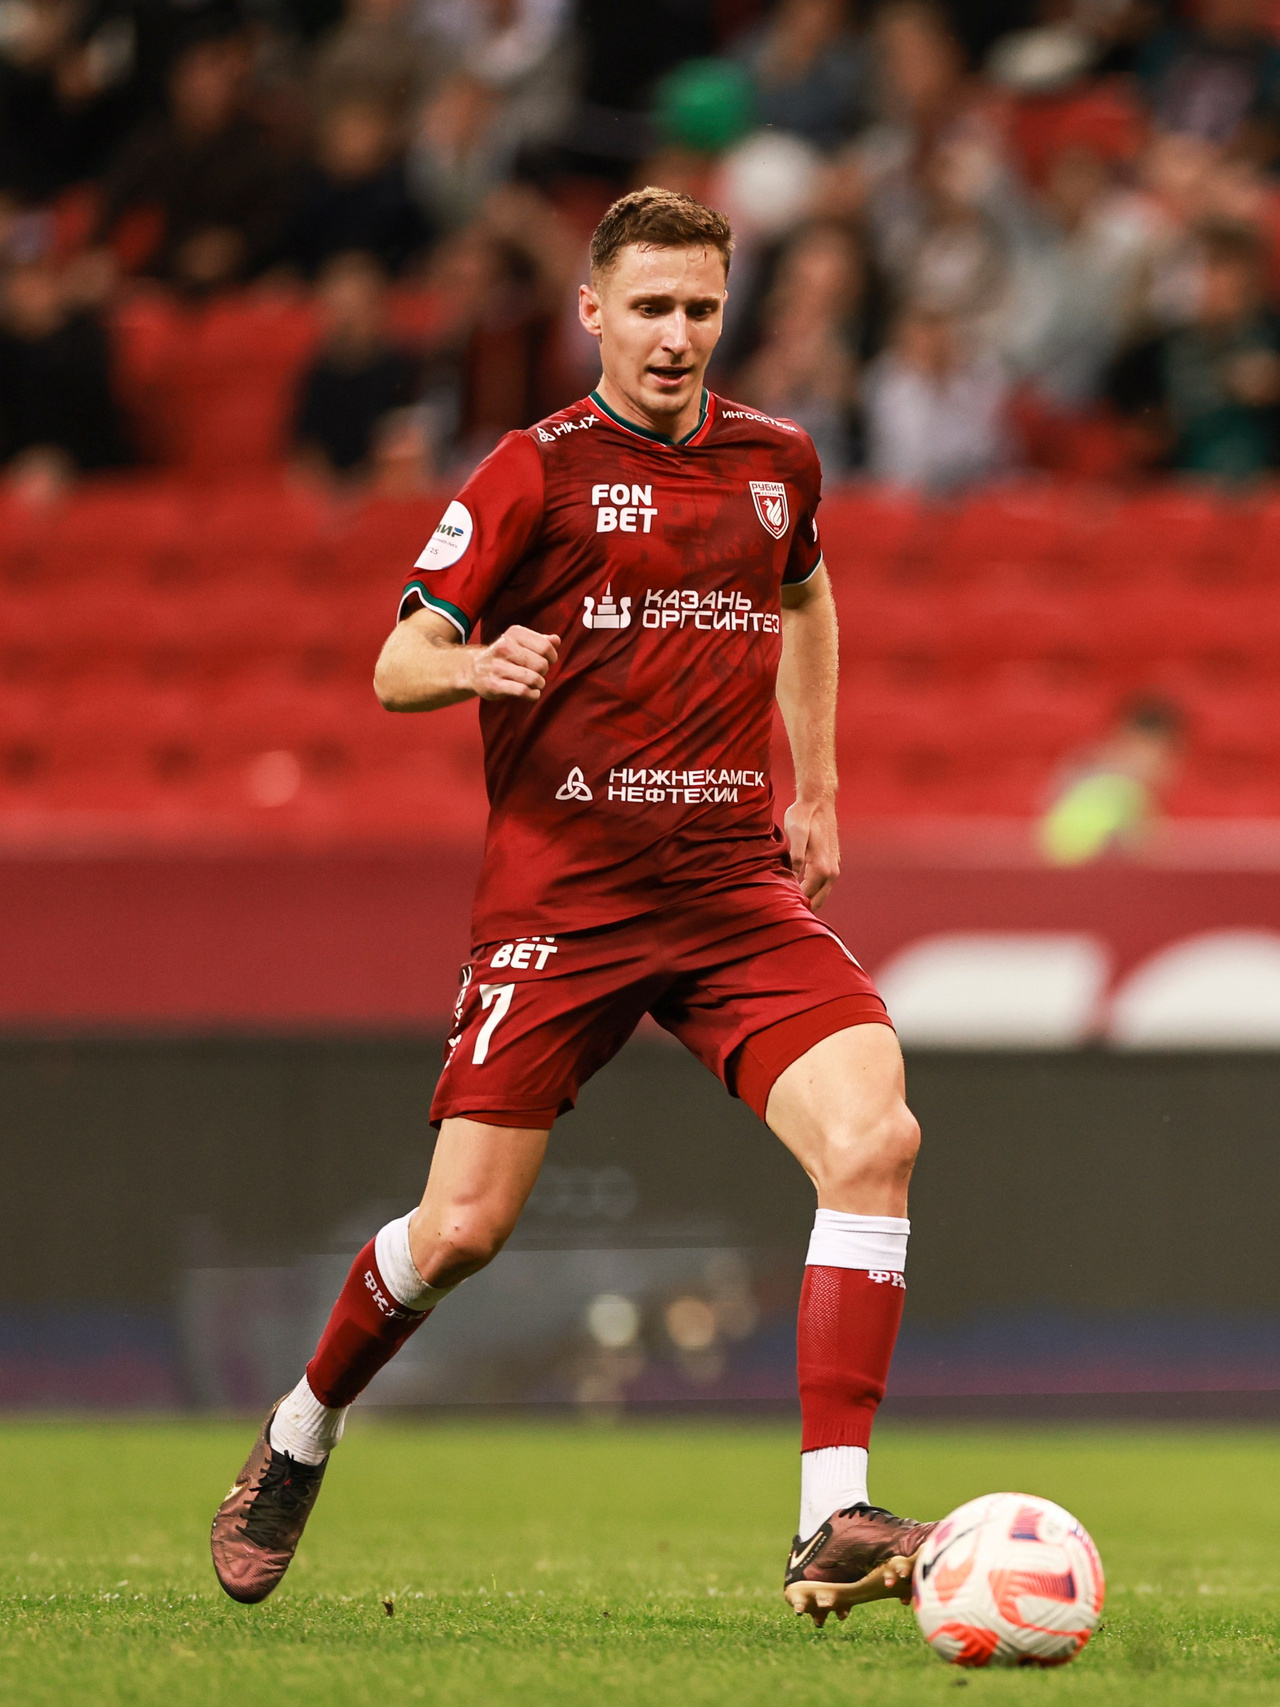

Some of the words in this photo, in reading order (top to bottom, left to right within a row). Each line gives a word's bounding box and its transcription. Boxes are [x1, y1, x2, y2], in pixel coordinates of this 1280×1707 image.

[591, 483, 652, 507] FON
[751, 483, 784, 493] РУБИН
[596, 507, 659, 533] BET
[644, 588, 752, 611] КАЗАНЬ
[642, 609, 780, 634] ОРГСИНТЕЗ
[608, 768, 765, 789] НИЖНЕКАМСК
[607, 786, 739, 805] НЕФТЕХИМ
[489, 942, 559, 971] BET
[471, 983, 516, 1065] 7
